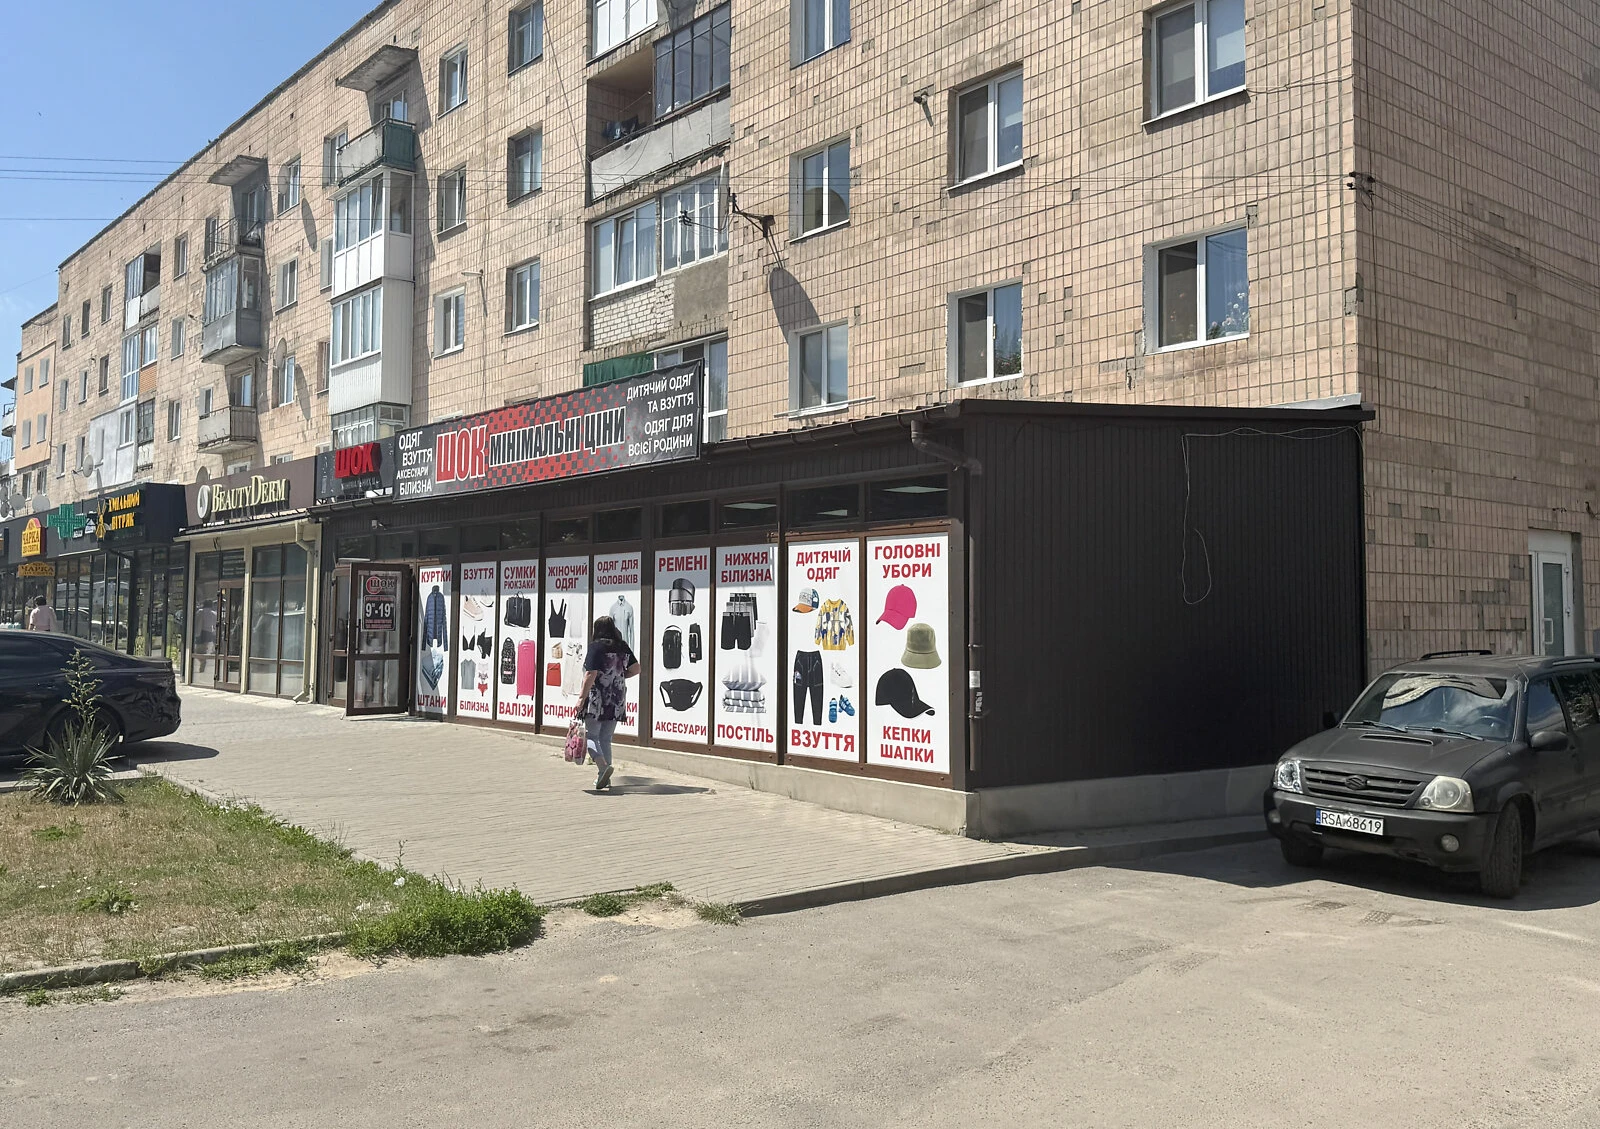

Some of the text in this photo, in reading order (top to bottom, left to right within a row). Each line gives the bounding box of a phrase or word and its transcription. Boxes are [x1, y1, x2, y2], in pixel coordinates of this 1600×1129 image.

[627, 373, 694, 402] ДИТЯЧИЙ ОДЯГ
[647, 392, 694, 413] ТА ВЗУТТЯ
[644, 413, 693, 436] ОДЯГ ДЛЯ
[398, 431, 423, 451] ОДЯГ
[435, 406, 626, 484] ШОК МІНІМАЛЬНІ ЦІНИ
[628, 433, 693, 457] ВСІЄЇ РОДИНИ
[335, 442, 375, 479] ШОК
[402, 448, 433, 466] ВЗУТТЯ
[396, 466, 429, 479] АКСЕСУАРИ
[400, 479, 432, 495] БІЛИЗНА
[724, 552, 768, 566] НИЖНЯ
[796, 547, 851, 567] ДИТЯЧІЙ
[874, 543, 941, 560] ГОЛОВНІ
[548, 563, 588, 577] ЖІНОЧИЙ
[597, 559, 639, 573] ОДЯГ ДЛЯ
[659, 555, 708, 572] РЕМЕНІ
[882, 563, 932, 579] УБОРИ
[421, 570, 452, 583] КУРТКИ
[463, 568, 494, 580] ВЗУТТЯ
[504, 565, 536, 579] СУМКИ
[597, 574, 638, 586] ЧОЛОВІКІВ
[721, 569, 772, 583] БІЛИЗНА
[807, 567, 840, 582] ОДЯГ
[370, 579, 395, 588] ШОК
[504, 580, 535, 589] РЮКЗАКИ
[555, 577, 579, 591] ОДЯГ
[417, 694, 447, 708] ШТАНИ
[460, 700, 490, 713] БІЛИЗНА
[499, 701, 534, 717] ВАЛІЗИ
[543, 704, 578, 719] СПІДНИ
[655, 721, 707, 736] АКСЕСУАРИ
[717, 724, 774, 743] ПОСТІЛЬ
[883, 726, 931, 744] КЕПКИ
[791, 729, 855, 753] ВЗУТТЯ
[880, 743, 934, 763] ШАПКИ
[1321, 811, 1342, 827] RSA
[1346, 816, 1382, 833] 68619
